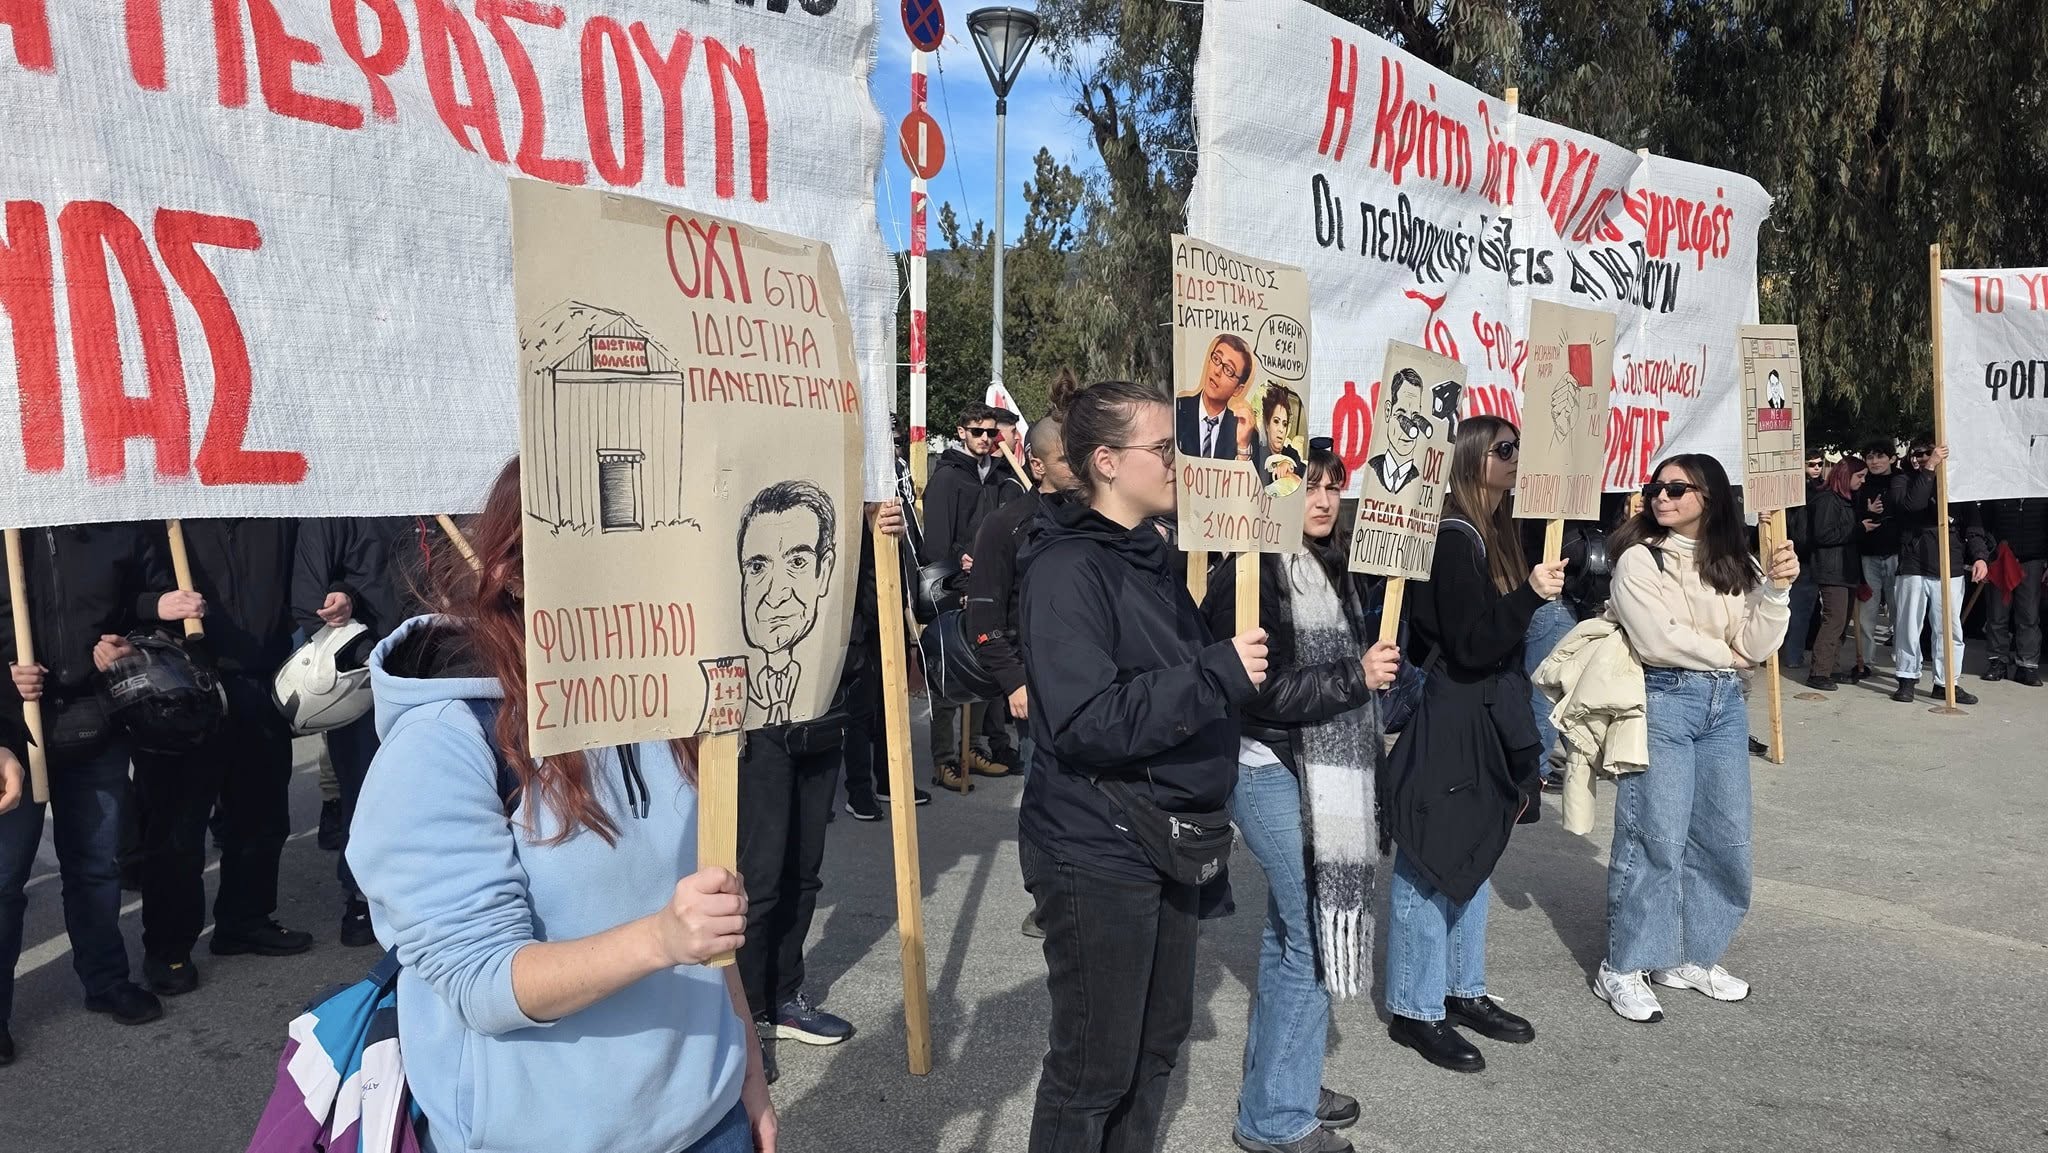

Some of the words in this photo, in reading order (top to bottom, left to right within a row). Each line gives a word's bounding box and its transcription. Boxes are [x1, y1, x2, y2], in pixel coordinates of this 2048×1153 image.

[1318, 36, 1358, 162] Η
[1369, 56, 1473, 194] Κρήτη
[1526, 137, 1600, 239] ΟΧΙ
[1312, 173, 1345, 251] Οι
[1360, 192, 1475, 284] πειθαρχικές
[666, 214, 752, 304] ΟΧΙ
[1176, 243, 1279, 290] ΑΠΟΦΟΙΤΟΣ
[1176, 273, 1268, 311] ΙΔΙΩΤΙΚΗΣ
[1966, 275, 2005, 314] ΤΟ
[1177, 304, 1253, 332] ΙΑΤΡΙΚΗΣ
[1269, 319, 1276, 336] Η
[594, 338, 645, 351] ΙΔΙΩΤΙΚΟ
[691, 310, 822, 368] ΙΔΙΩΤΙΚΑ
[1275, 338, 1296, 355] ΕΧΕΙ
[593, 353, 648, 368] ΚΟΛΛΕΓΙΟ
[689, 367, 860, 415] ΠΑΝΕΠΙΣΤΗΜΙΑ
[1422, 446, 1445, 484] ΟΧΙ
[1183, 463, 1273, 519] ΦΟΙΤΗΤΙΚΟΙ
[1203, 510, 1282, 545] ΣΥΛΛΟΓΟΙ
[532, 601, 696, 663] ΦΟΙΤΗΤΙΚΟΙ
[715, 681, 743, 701] 1+1
